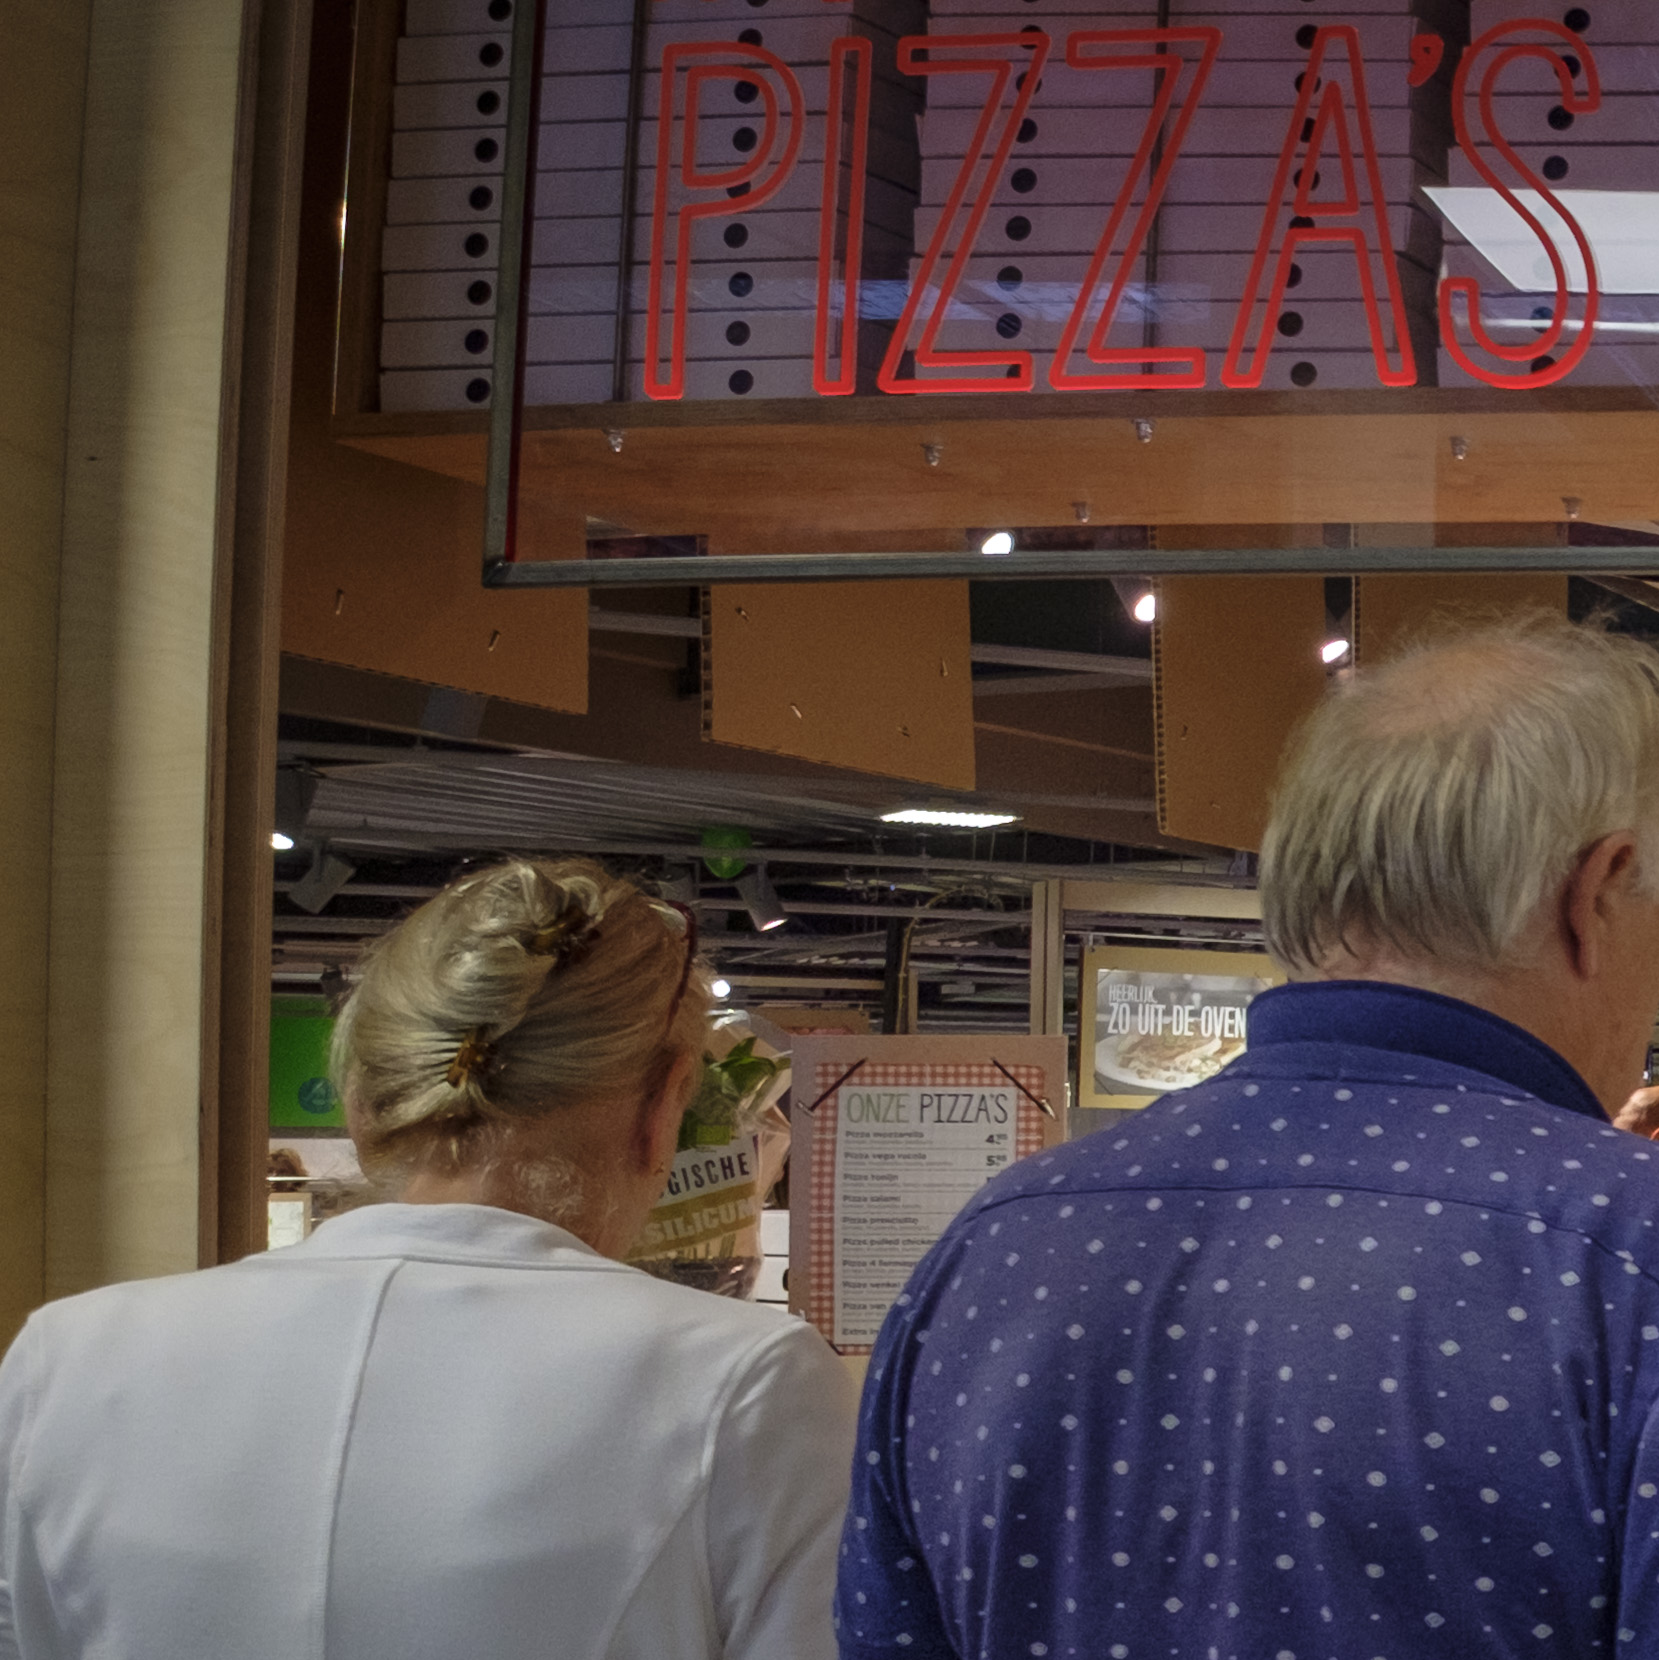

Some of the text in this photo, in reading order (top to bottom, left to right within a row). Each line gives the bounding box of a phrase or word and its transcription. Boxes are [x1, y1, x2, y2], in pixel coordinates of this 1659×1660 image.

[645, 19, 1601, 401] PIZZA'S
[1107, 1003, 1131, 1035] ZO
[1138, 1004, 1166, 1036] UIT
[1172, 1005, 1195, 1036] DE
[847, 1093, 1008, 1123] ONZE PIZZA'S
[667, 1153, 749, 1196] GISCHE
